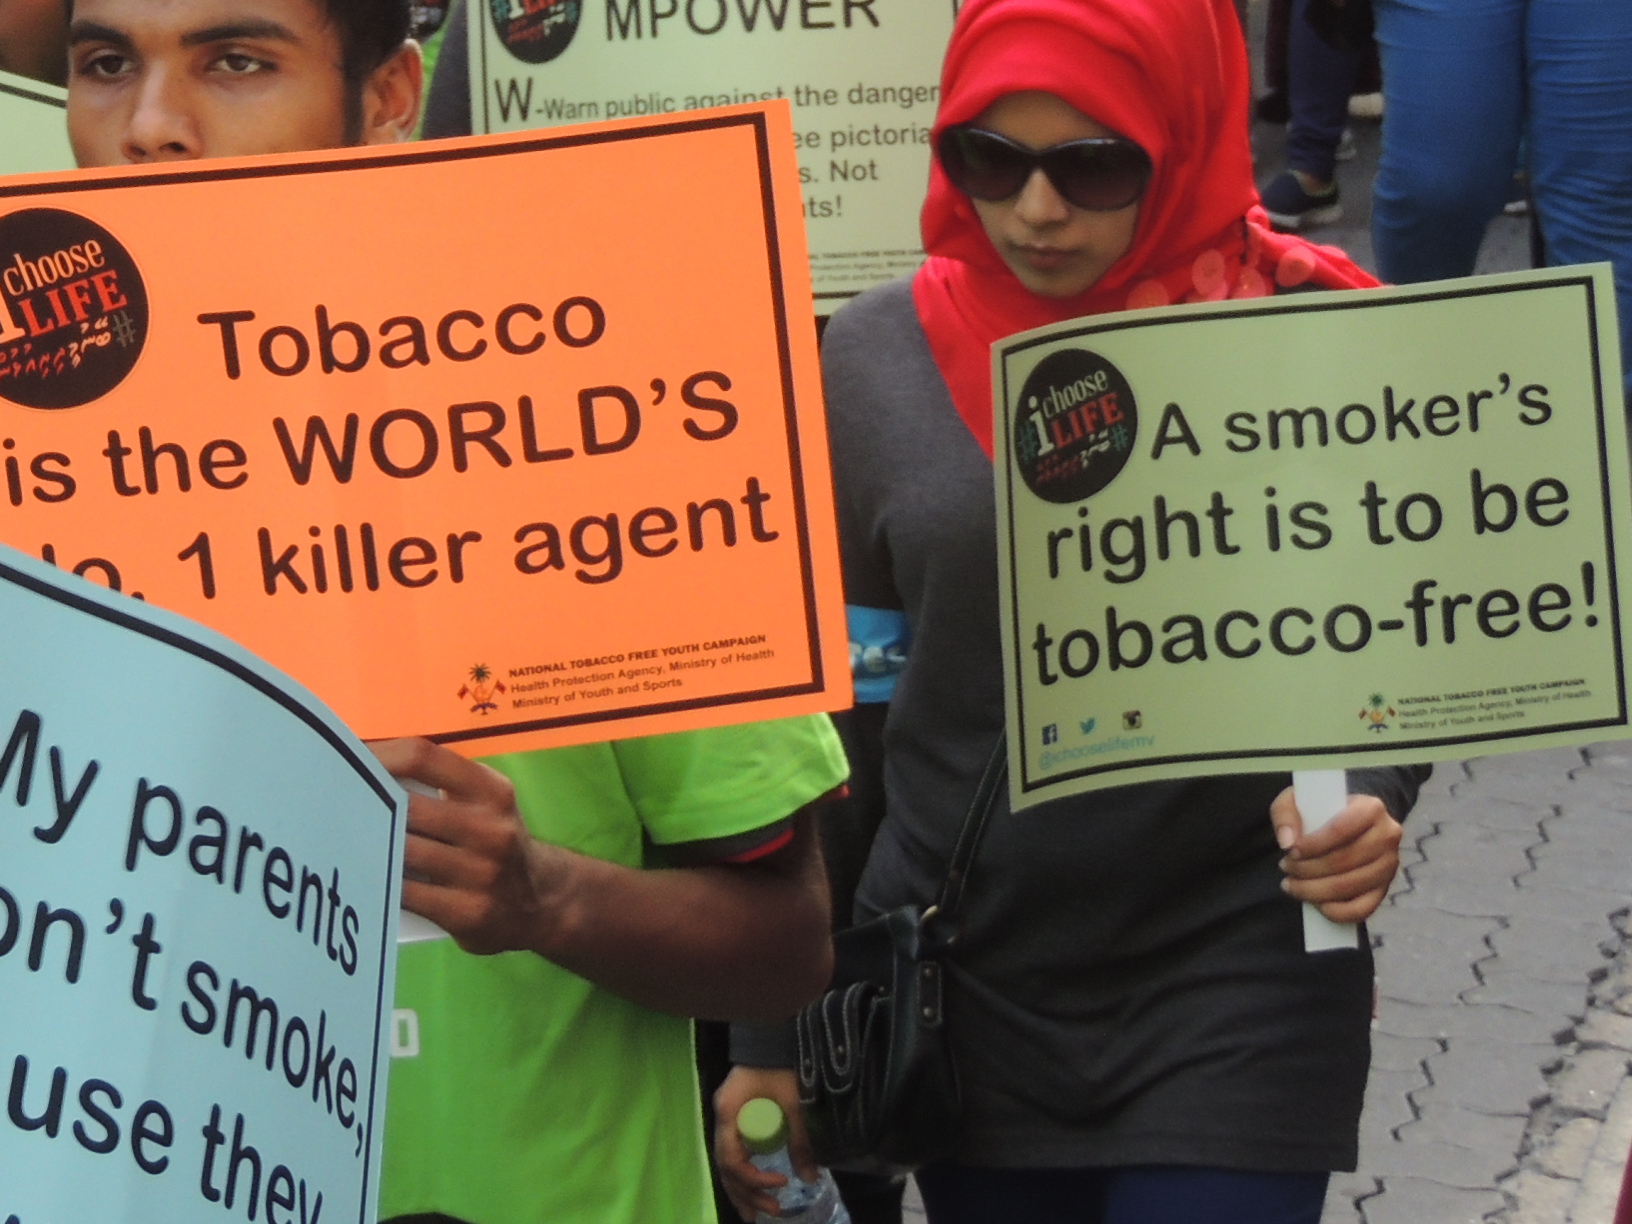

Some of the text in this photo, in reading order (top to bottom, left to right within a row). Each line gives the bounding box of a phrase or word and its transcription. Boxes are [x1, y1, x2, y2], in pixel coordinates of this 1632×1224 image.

[606, 93, 676, 120] public
[795, 83, 838, 107] the
[830, 159, 878, 182] Not
[802, 194, 842, 217] ts!
[3, 239, 106, 297] choose
[19, 269, 129, 338] LIFE
[196, 292, 607, 381] Tobacco
[1043, 370, 1108, 419] choose
[1052, 392, 1125, 448] LIFE
[1151, 372, 1554, 461] A smoker's
[2, 369, 741, 507] is the WORLD'S
[178, 531, 217, 600] 1
[256, 521, 483, 597] killer
[512, 475, 782, 585] agent
[1046, 468, 1570, 584] right is to be
[509, 634, 767, 678] NATIONAL TOBACCO FREE YOUTH CAMPAIGN
[1031, 560, 1601, 687] tobacco-free!
[510, 647, 776, 694] Health Protection Agency, Ministry of Health
[512, 677, 683, 712] Ministry of Youth and Sports
[125, 776, 360, 977] parents
[181, 960, 366, 1158] smoke,
[201, 1103, 323, 1224] they
